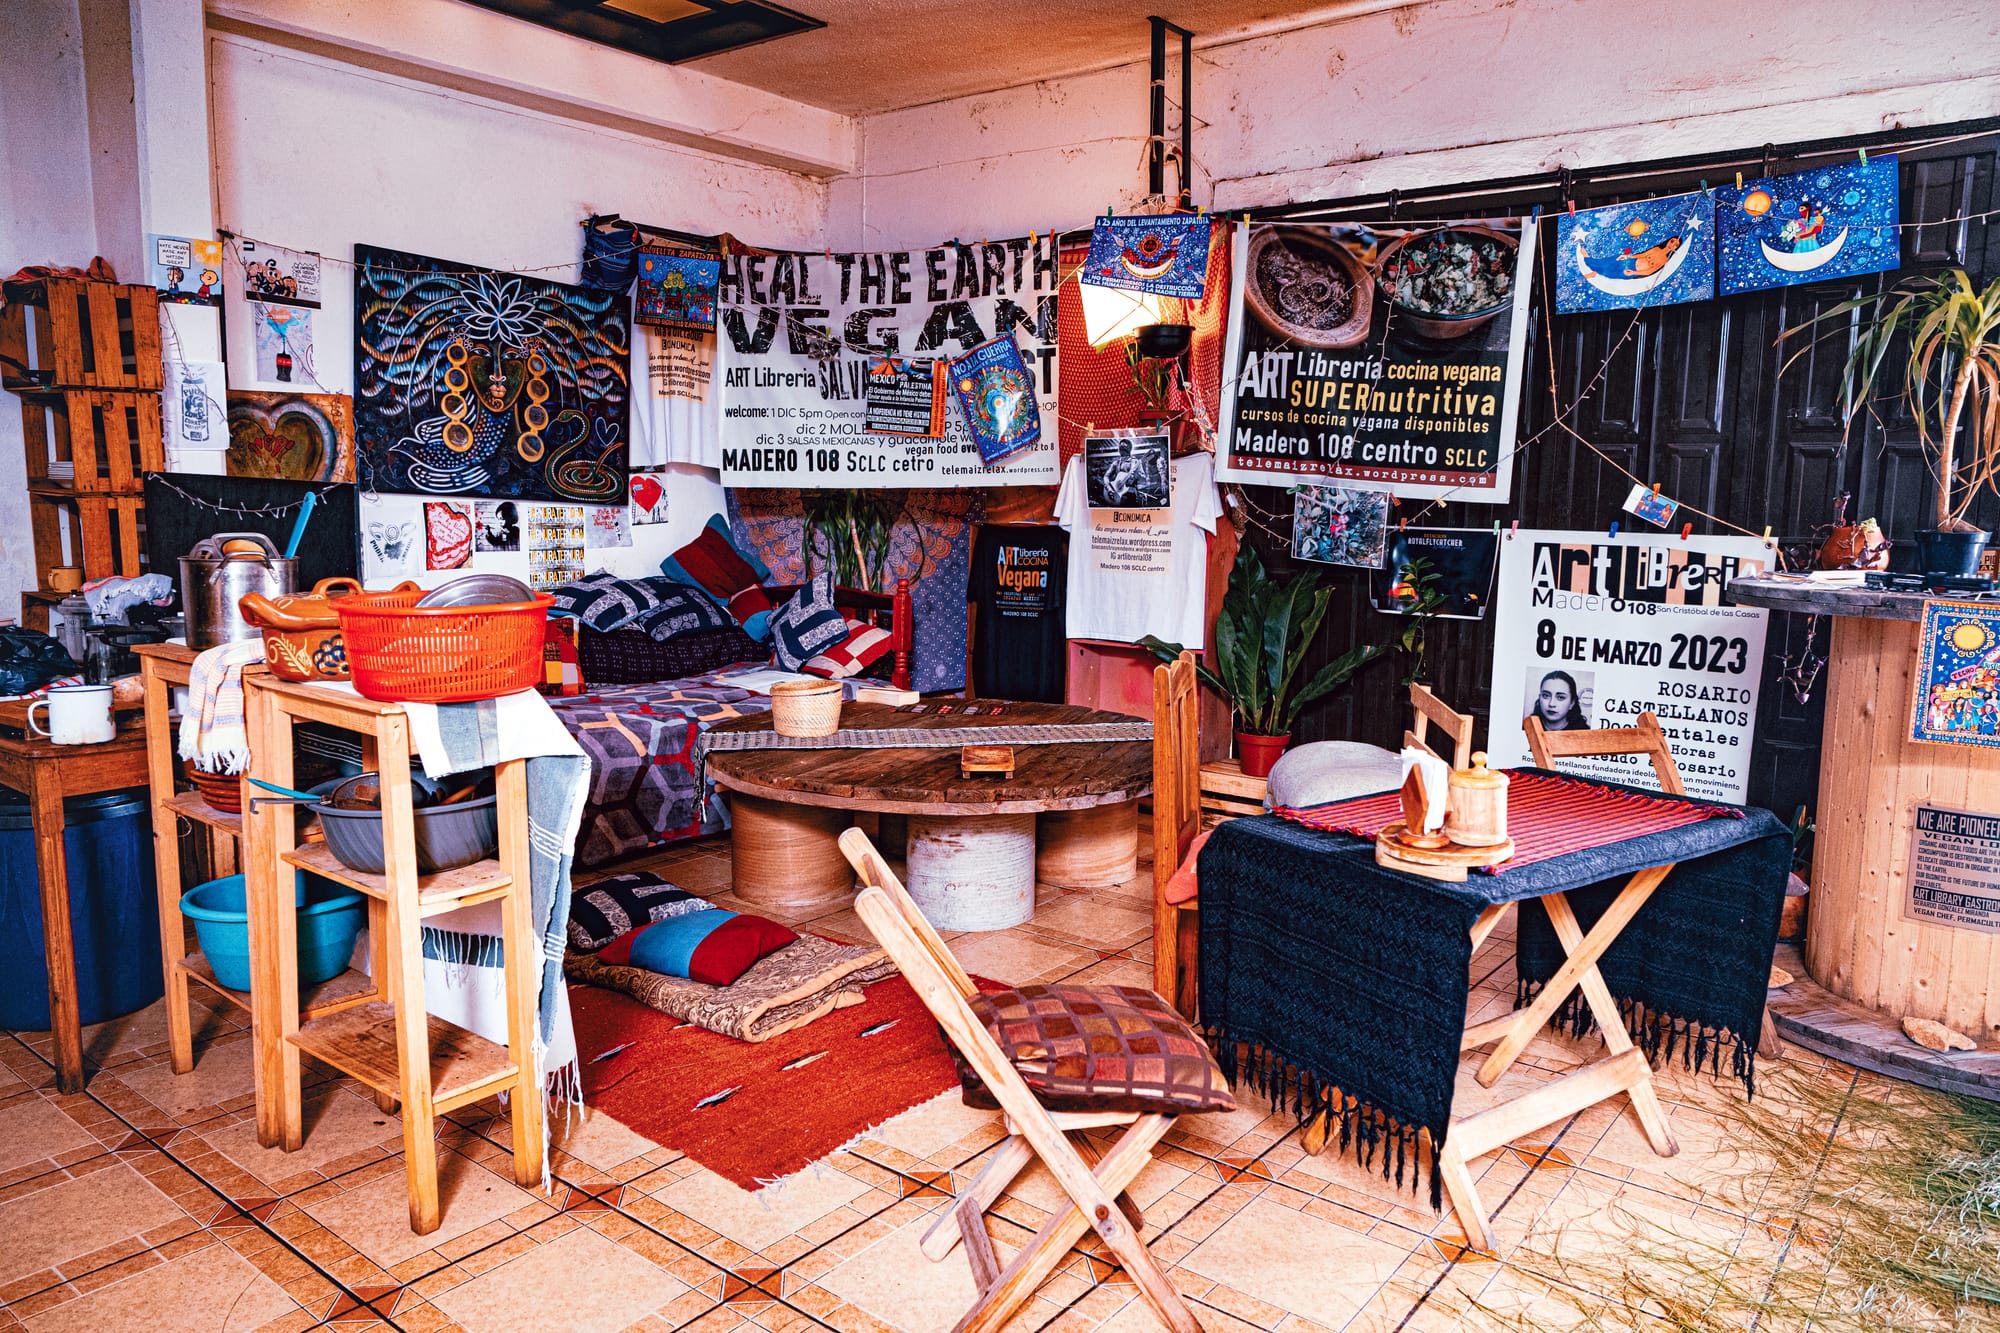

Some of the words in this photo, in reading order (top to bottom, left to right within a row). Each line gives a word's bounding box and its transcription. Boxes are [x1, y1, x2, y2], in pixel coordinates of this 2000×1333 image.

[1127, 219, 1137, 227] DEL
[1138, 217, 1180, 227] LEVANTAMIENTO
[719, 254, 821, 305] HEAL
[835, 251, 911, 304] THE
[928, 238, 1058, 302] EARTH
[718, 295, 1058, 354] VEGAN
[954, 364, 966, 376] NO
[978, 340, 1012, 360] GUERRA
[725, 368, 750, 388] ART
[754, 367, 816, 388] Libreria
[1238, 351, 1294, 400] ART
[1297, 352, 1383, 380] Librería
[1388, 360, 1438, 381] cocina
[1443, 364, 1501, 386] vegana
[900, 381, 932, 390] PALESTINA
[725, 404, 769, 418] welcome:
[777, 408, 796, 418] DIC
[799, 408, 822, 421] 5pm
[825, 410, 848, 420] Open
[1242, 408, 1284, 422] cursos
[1287, 409, 1299, 423] de
[1304, 412, 1347, 427] cocina
[1352, 416, 1399, 432] vegana
[1404, 416, 1489, 435] disponibles
[796, 424, 816, 435] dic
[819, 424, 826, 435] 2
[756, 434, 774, 445] dic
[777, 434, 785, 445] 3
[787, 437, 821, 446] SALSAS
[822, 437, 876, 446] MEXICANAS
[878, 437, 885, 448] y
[888, 434, 957, 448] guacamole
[905, 444, 933, 456] vegan
[937, 443, 958, 454] food
[1040, 443, 1049, 451] to
[1235, 427, 1309, 456] Madero
[1318, 432, 1354, 459] 108
[1362, 440, 1437, 465] centro
[1445, 448, 1488, 468] SCLC
[722, 448, 798, 472] MADERO
[805, 449, 840, 472] 108
[893, 456, 934, 472] cetro
[942, 465, 1054, 475] telemaizrelax.wordpress.com
[1238, 457, 1488, 485] telemaizrelax.wordpress.com
[1113, 511, 1151, 523] ECONOMICA
[998, 546, 1019, 566] ART
[1017, 557, 1049, 566] COCINA
[998, 565, 1048, 592] Vegana
[1532, 544, 1612, 597] Art
[1628, 602, 1657, 616] 108
[1656, 605, 1672, 614] San
[1673, 606, 1709, 616] Cristóbal
[1710, 608, 1720, 616] de
[1722, 609, 1734, 618] las
[1735, 610, 1760, 619] Casas
[1536, 618, 1557, 658] 8
[1561, 636, 1587, 661] DE
[1592, 638, 1662, 667] MARZO
[1669, 633, 1748, 674] 2023
[1951, 667, 1975, 679] TECHO
[1657, 681, 1751, 705] ROSARIO
[1605, 699, 1749, 727] CASTELLANOS
[1671, 744, 1716, 759] Horas
[1592, 764, 1631, 775] fundadora
[1695, 779, 1740, 791] movimiento
[1674, 759, 1736, 778] osario
[1628, 777, 1640, 785] NO
[1920, 810, 1934, 830] WE
[1936, 814, 1956, 833] ARE
[1924, 832, 1974, 845] VEGAN
[1914, 888, 1929, 900] ART
[1931, 890, 1963, 905] LIBRARY
[1914, 907, 1935, 917] VEGAN
